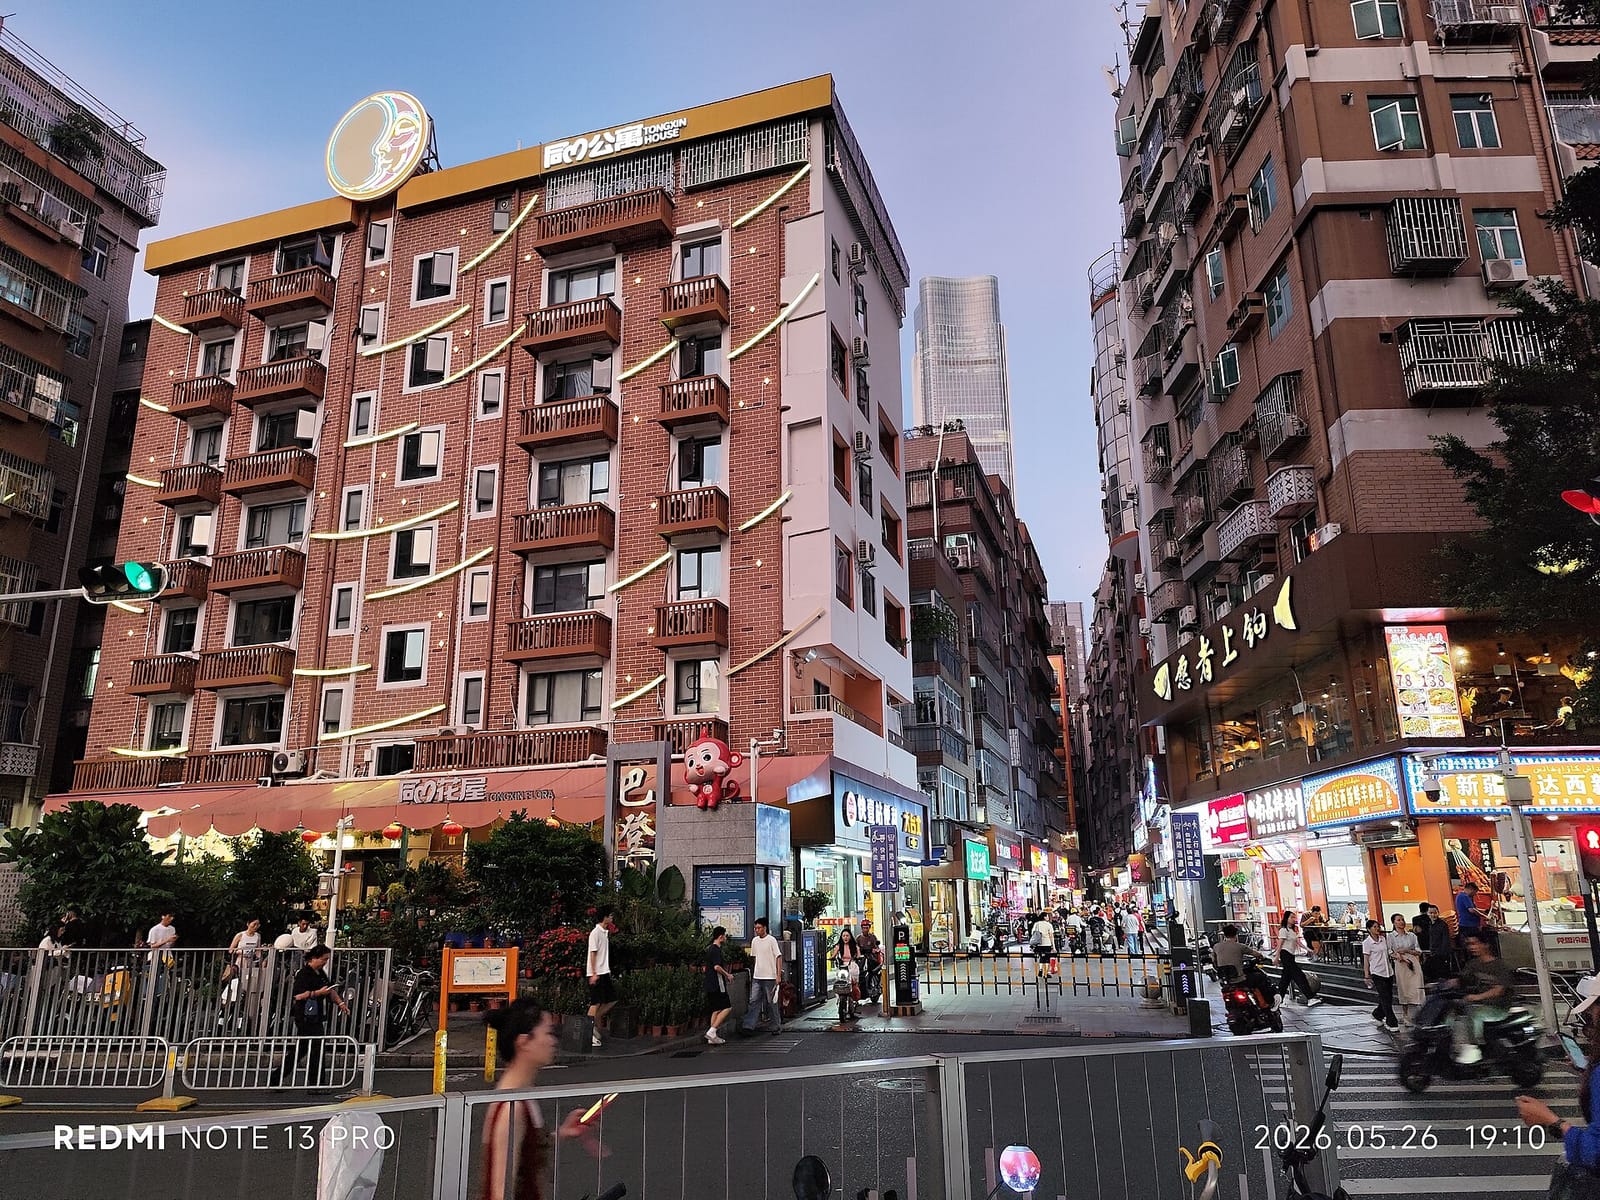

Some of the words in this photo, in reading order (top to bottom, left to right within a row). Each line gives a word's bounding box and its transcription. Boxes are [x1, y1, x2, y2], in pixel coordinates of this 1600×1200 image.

[643, 117, 687, 136] TONGXIN
[644, 128, 679, 145] HOUSE
[1456, 772, 1600, 797] 新疆达西
[898, 931, 905, 941] P
